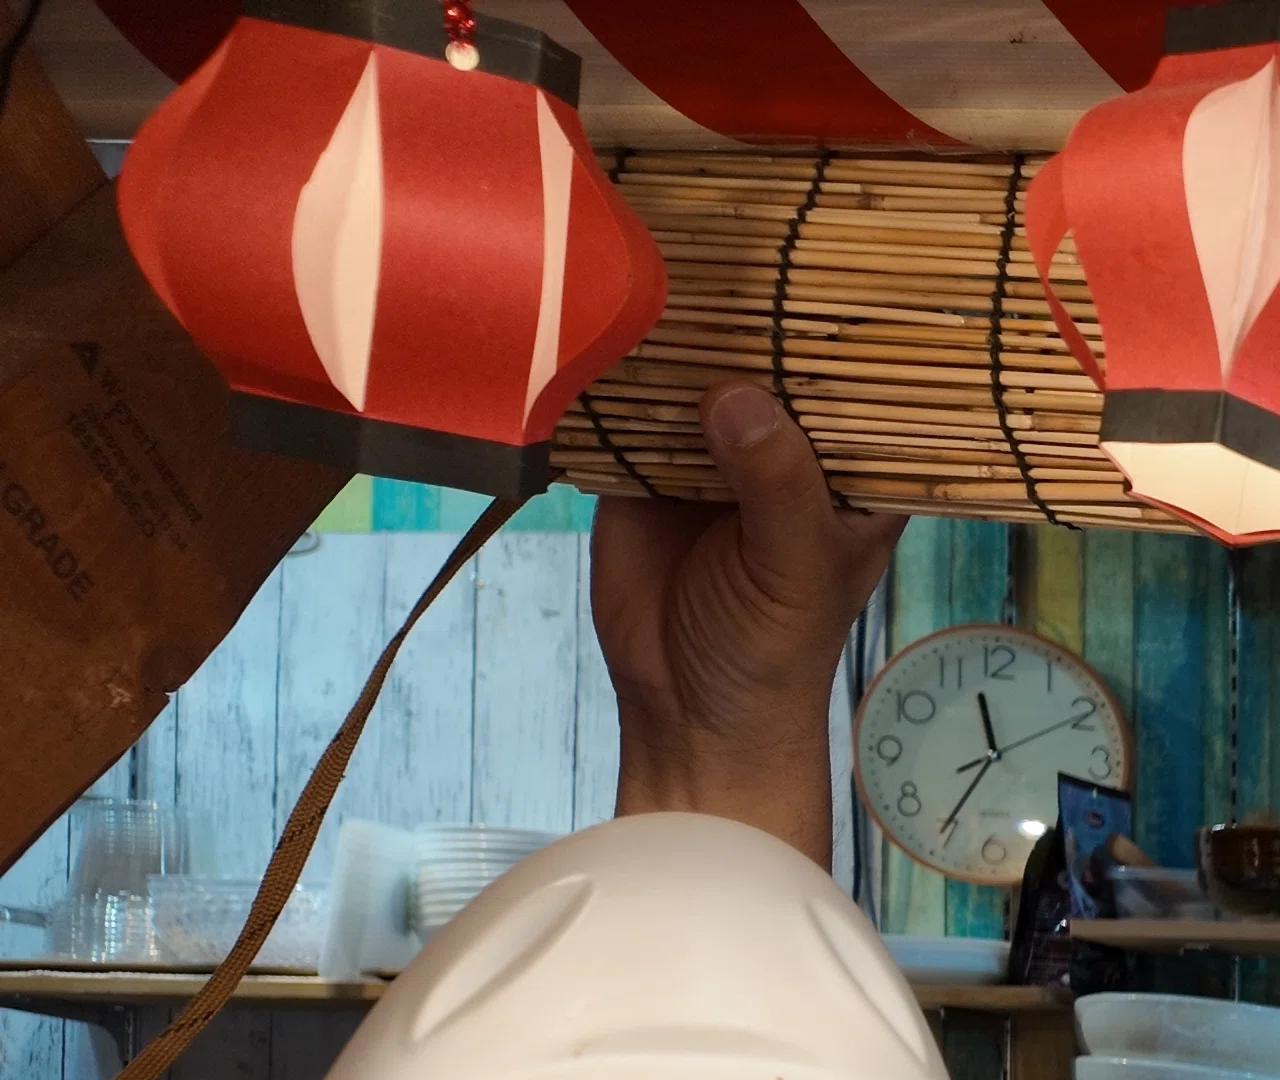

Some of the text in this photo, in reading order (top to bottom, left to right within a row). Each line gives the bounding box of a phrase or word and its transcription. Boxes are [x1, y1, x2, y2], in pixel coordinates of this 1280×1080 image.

[2, 482, 95, 601] GRADE
[940, 656, 962, 689] 11
[984, 645, 1016, 681] 12
[896, 689, 936, 724] 10
[1071, 696, 1096, 732] 2
[877, 735, 902, 766] 9
[1088, 747, 1112, 781] 3
[897, 780, 922, 817] 8
[981, 834, 1006, 865] 6
